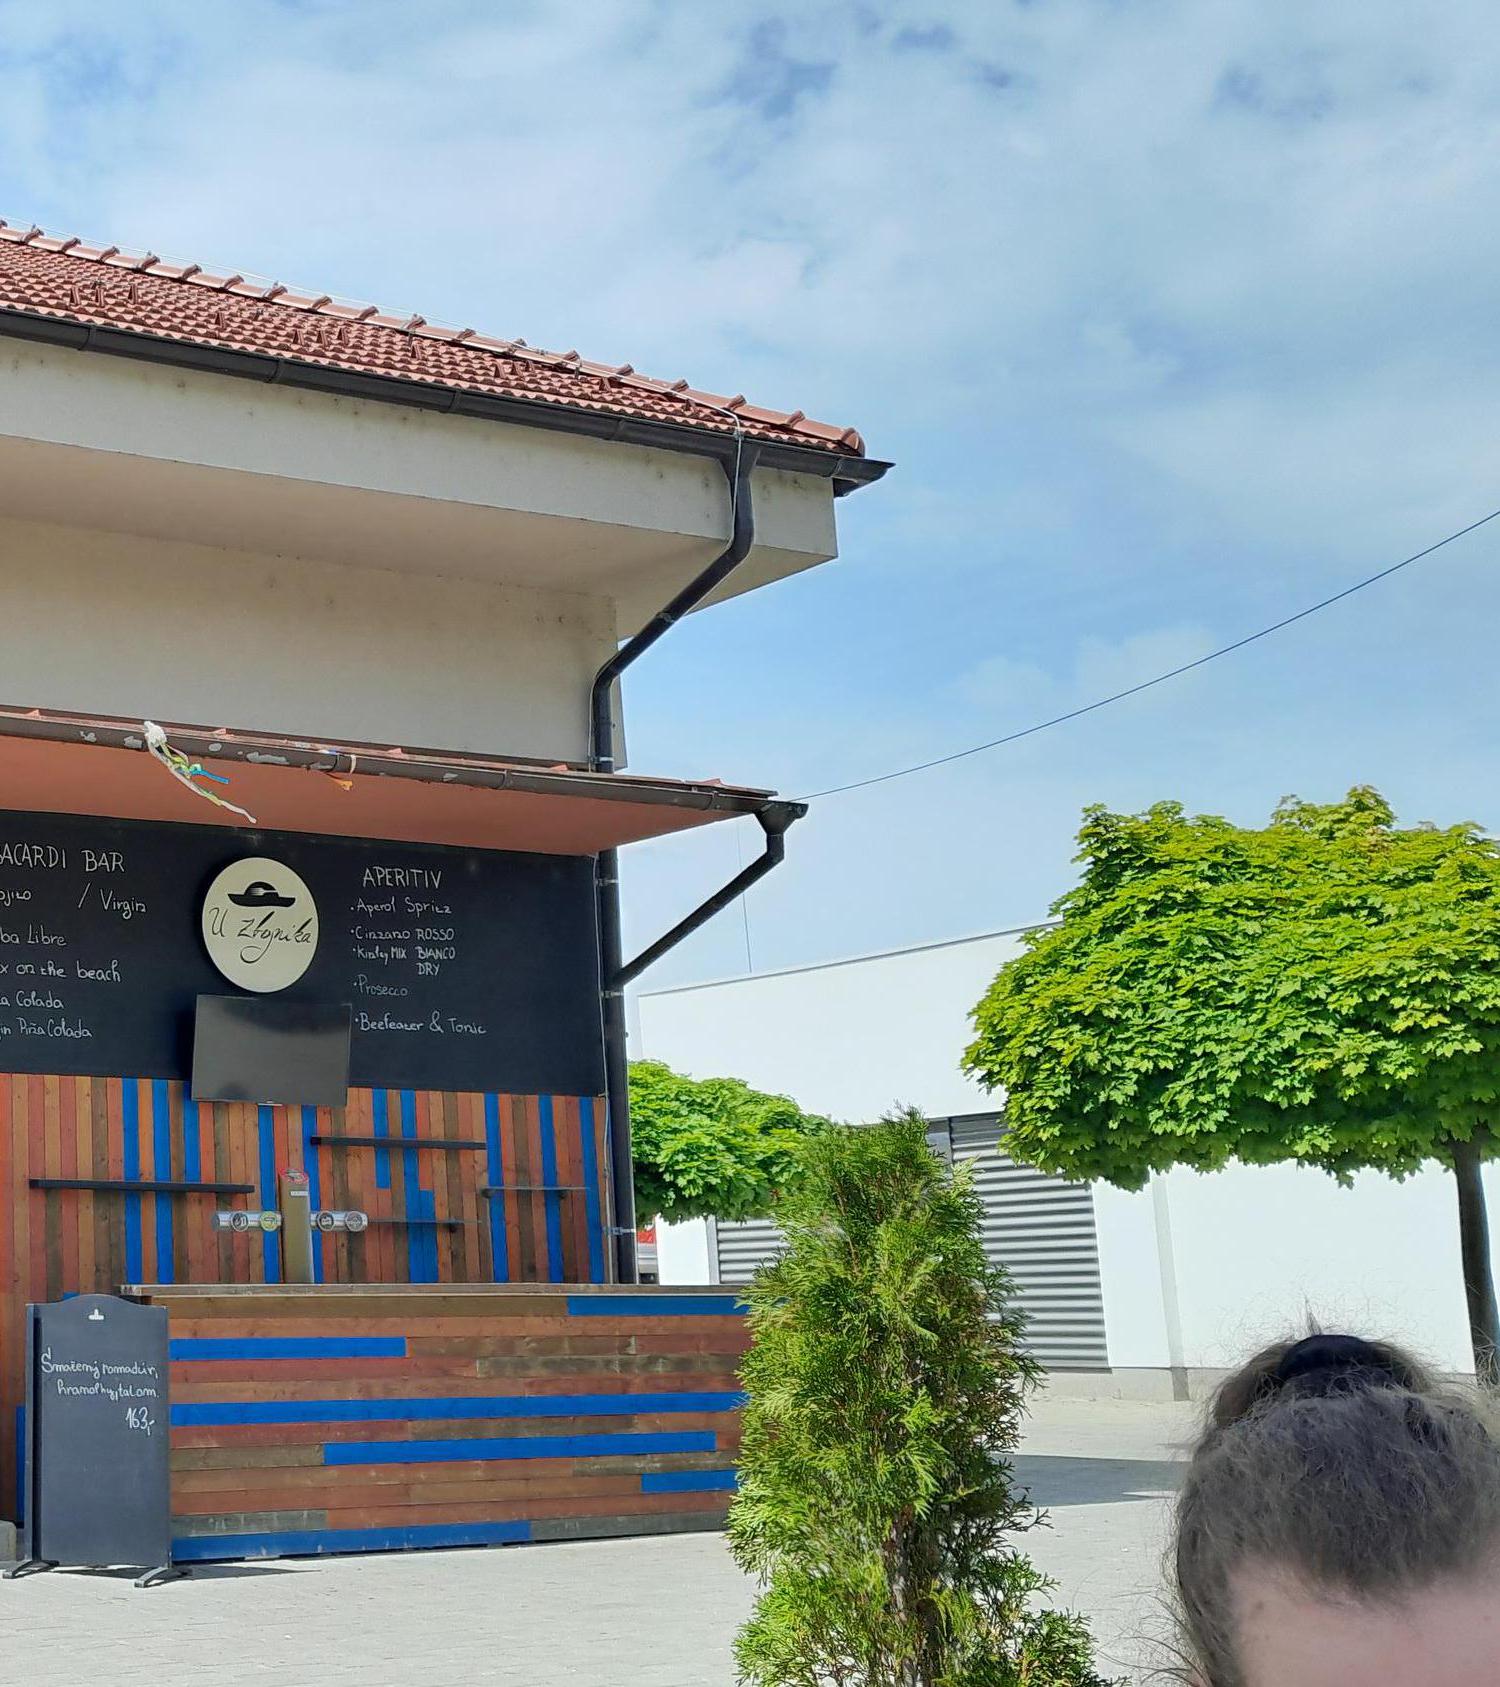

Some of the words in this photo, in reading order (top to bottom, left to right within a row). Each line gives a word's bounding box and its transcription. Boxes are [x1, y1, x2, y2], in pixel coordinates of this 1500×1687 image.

[82, 850, 125, 873] BAR
[363, 866, 442, 889] APERITIV
[100, 888, 147, 920] Virgin
[357, 896, 396, 918] Aperol
[208, 907, 228, 938] U
[355, 925, 411, 940] Cinzano
[415, 928, 455, 941] ROSSO
[27, 924, 67, 946] Libre
[415, 946, 456, 960] BIANCO
[16, 964, 36, 974] on
[40, 961, 67, 978] the
[77, 959, 122, 983] beach
[416, 962, 441, 976] DRY
[357, 973, 408, 996] Prosecco
[16, 990, 65, 1009] Colada
[47, 1017, 93, 1039] Colada
[359, 1012, 424, 1031] Beefeater
[428, 1010, 444, 1034] &
[447, 1017, 487, 1035] Tonic
